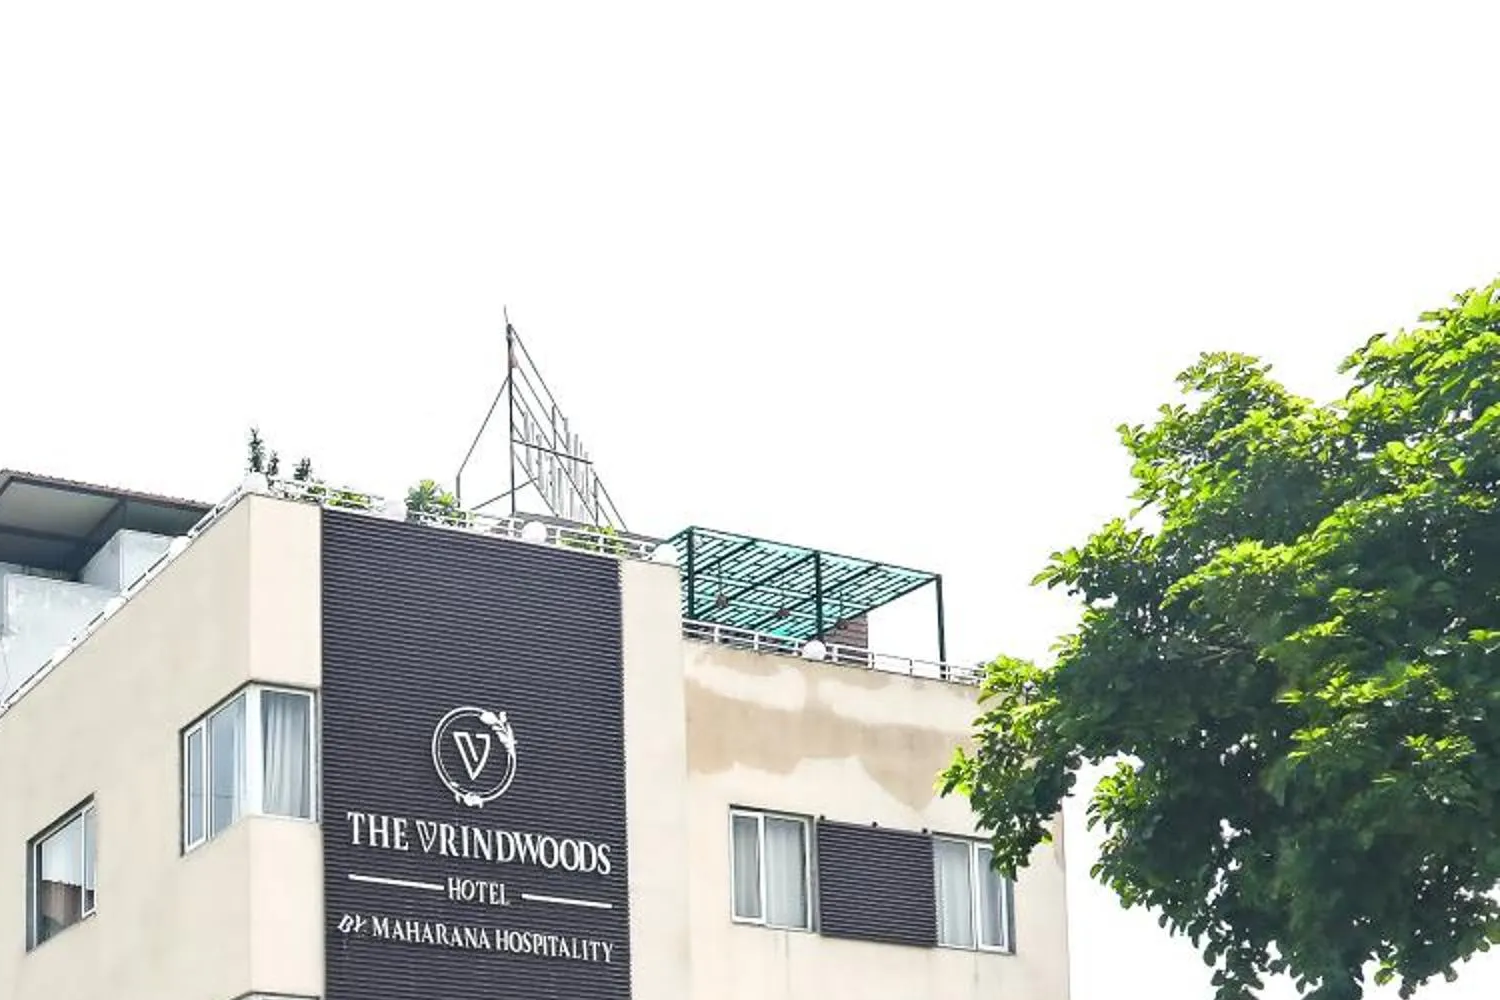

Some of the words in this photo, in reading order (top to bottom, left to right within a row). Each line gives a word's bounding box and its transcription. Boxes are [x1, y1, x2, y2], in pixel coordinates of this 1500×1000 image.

[346, 811, 410, 852] THE
[414, 819, 613, 876] VRINDWOODS
[447, 877, 510, 906] HOTEL
[337, 913, 367, 934] BY
[371, 914, 491, 951] MAHARANA
[495, 929, 615, 964] HOSPITALITY
